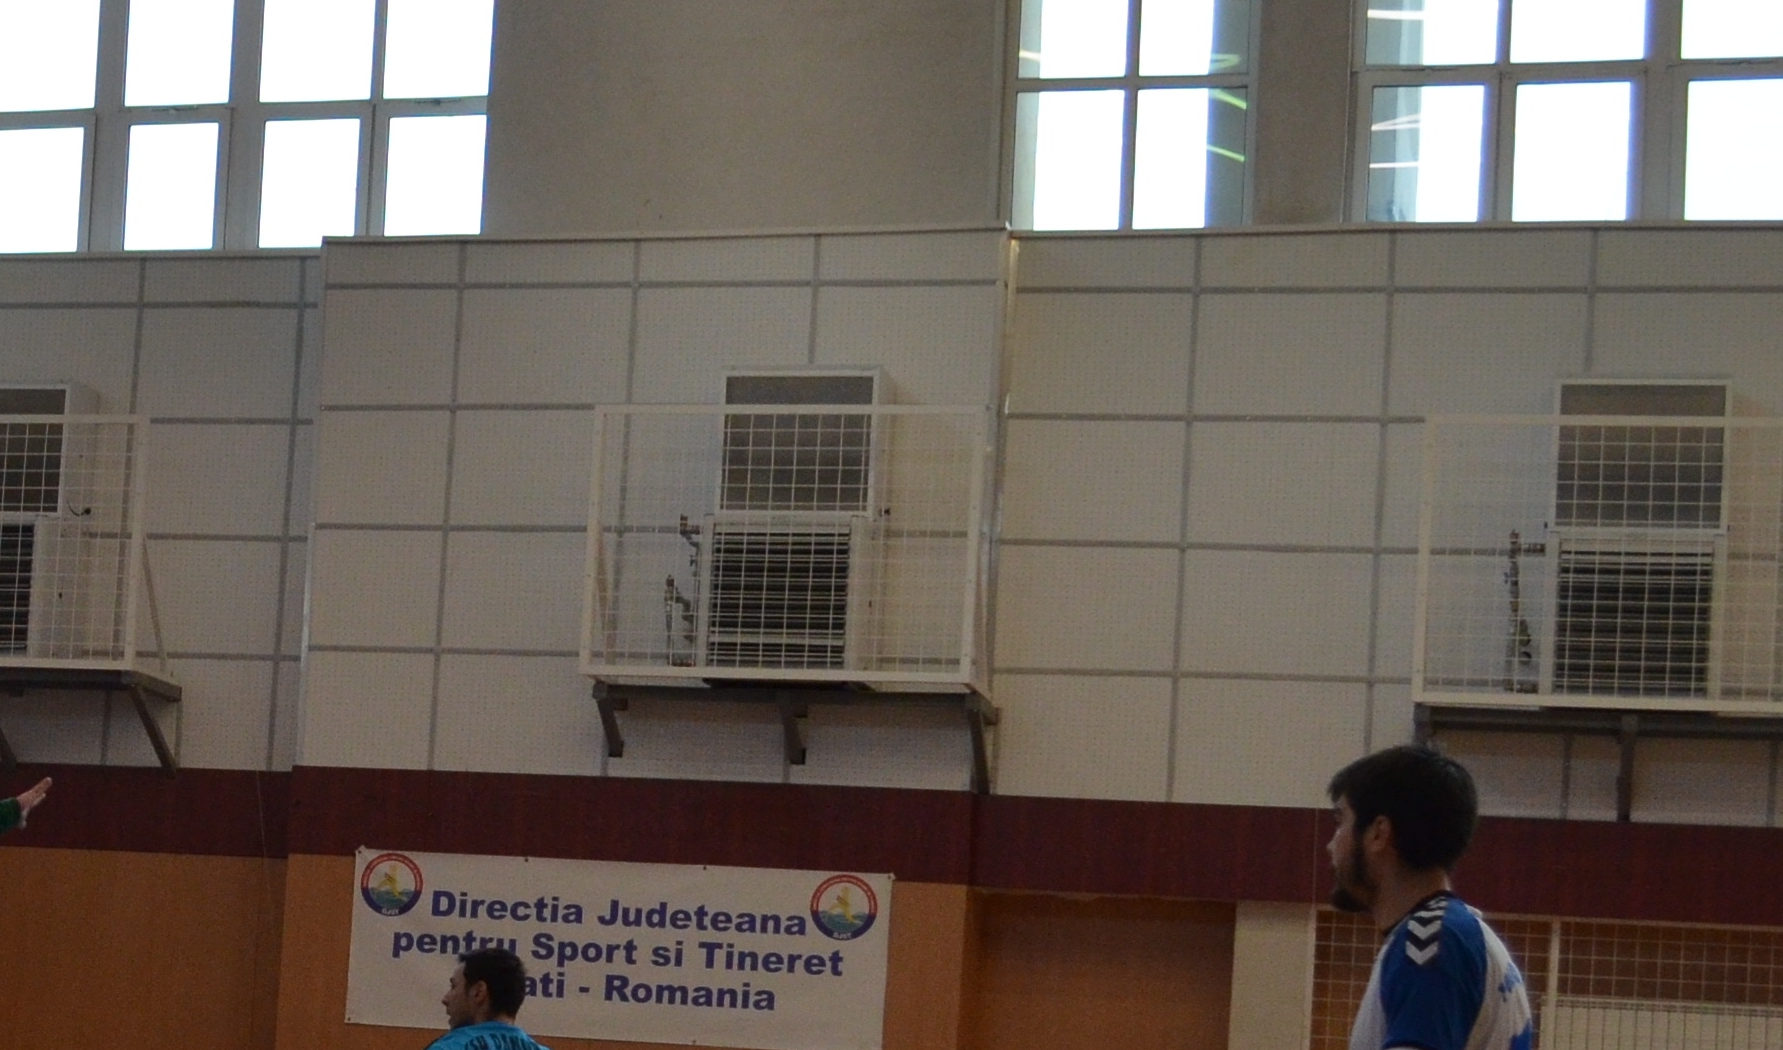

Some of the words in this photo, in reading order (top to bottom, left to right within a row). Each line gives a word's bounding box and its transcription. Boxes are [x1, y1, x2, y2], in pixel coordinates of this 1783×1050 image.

[431, 889, 583, 925] Directia
[598, 899, 806, 936] Judeteana
[392, 927, 518, 958] pentru
[531, 931, 637, 967] Sport
[651, 940, 683, 967] si
[698, 942, 844, 977] Tineret
[604, 974, 776, 1012] Romania
